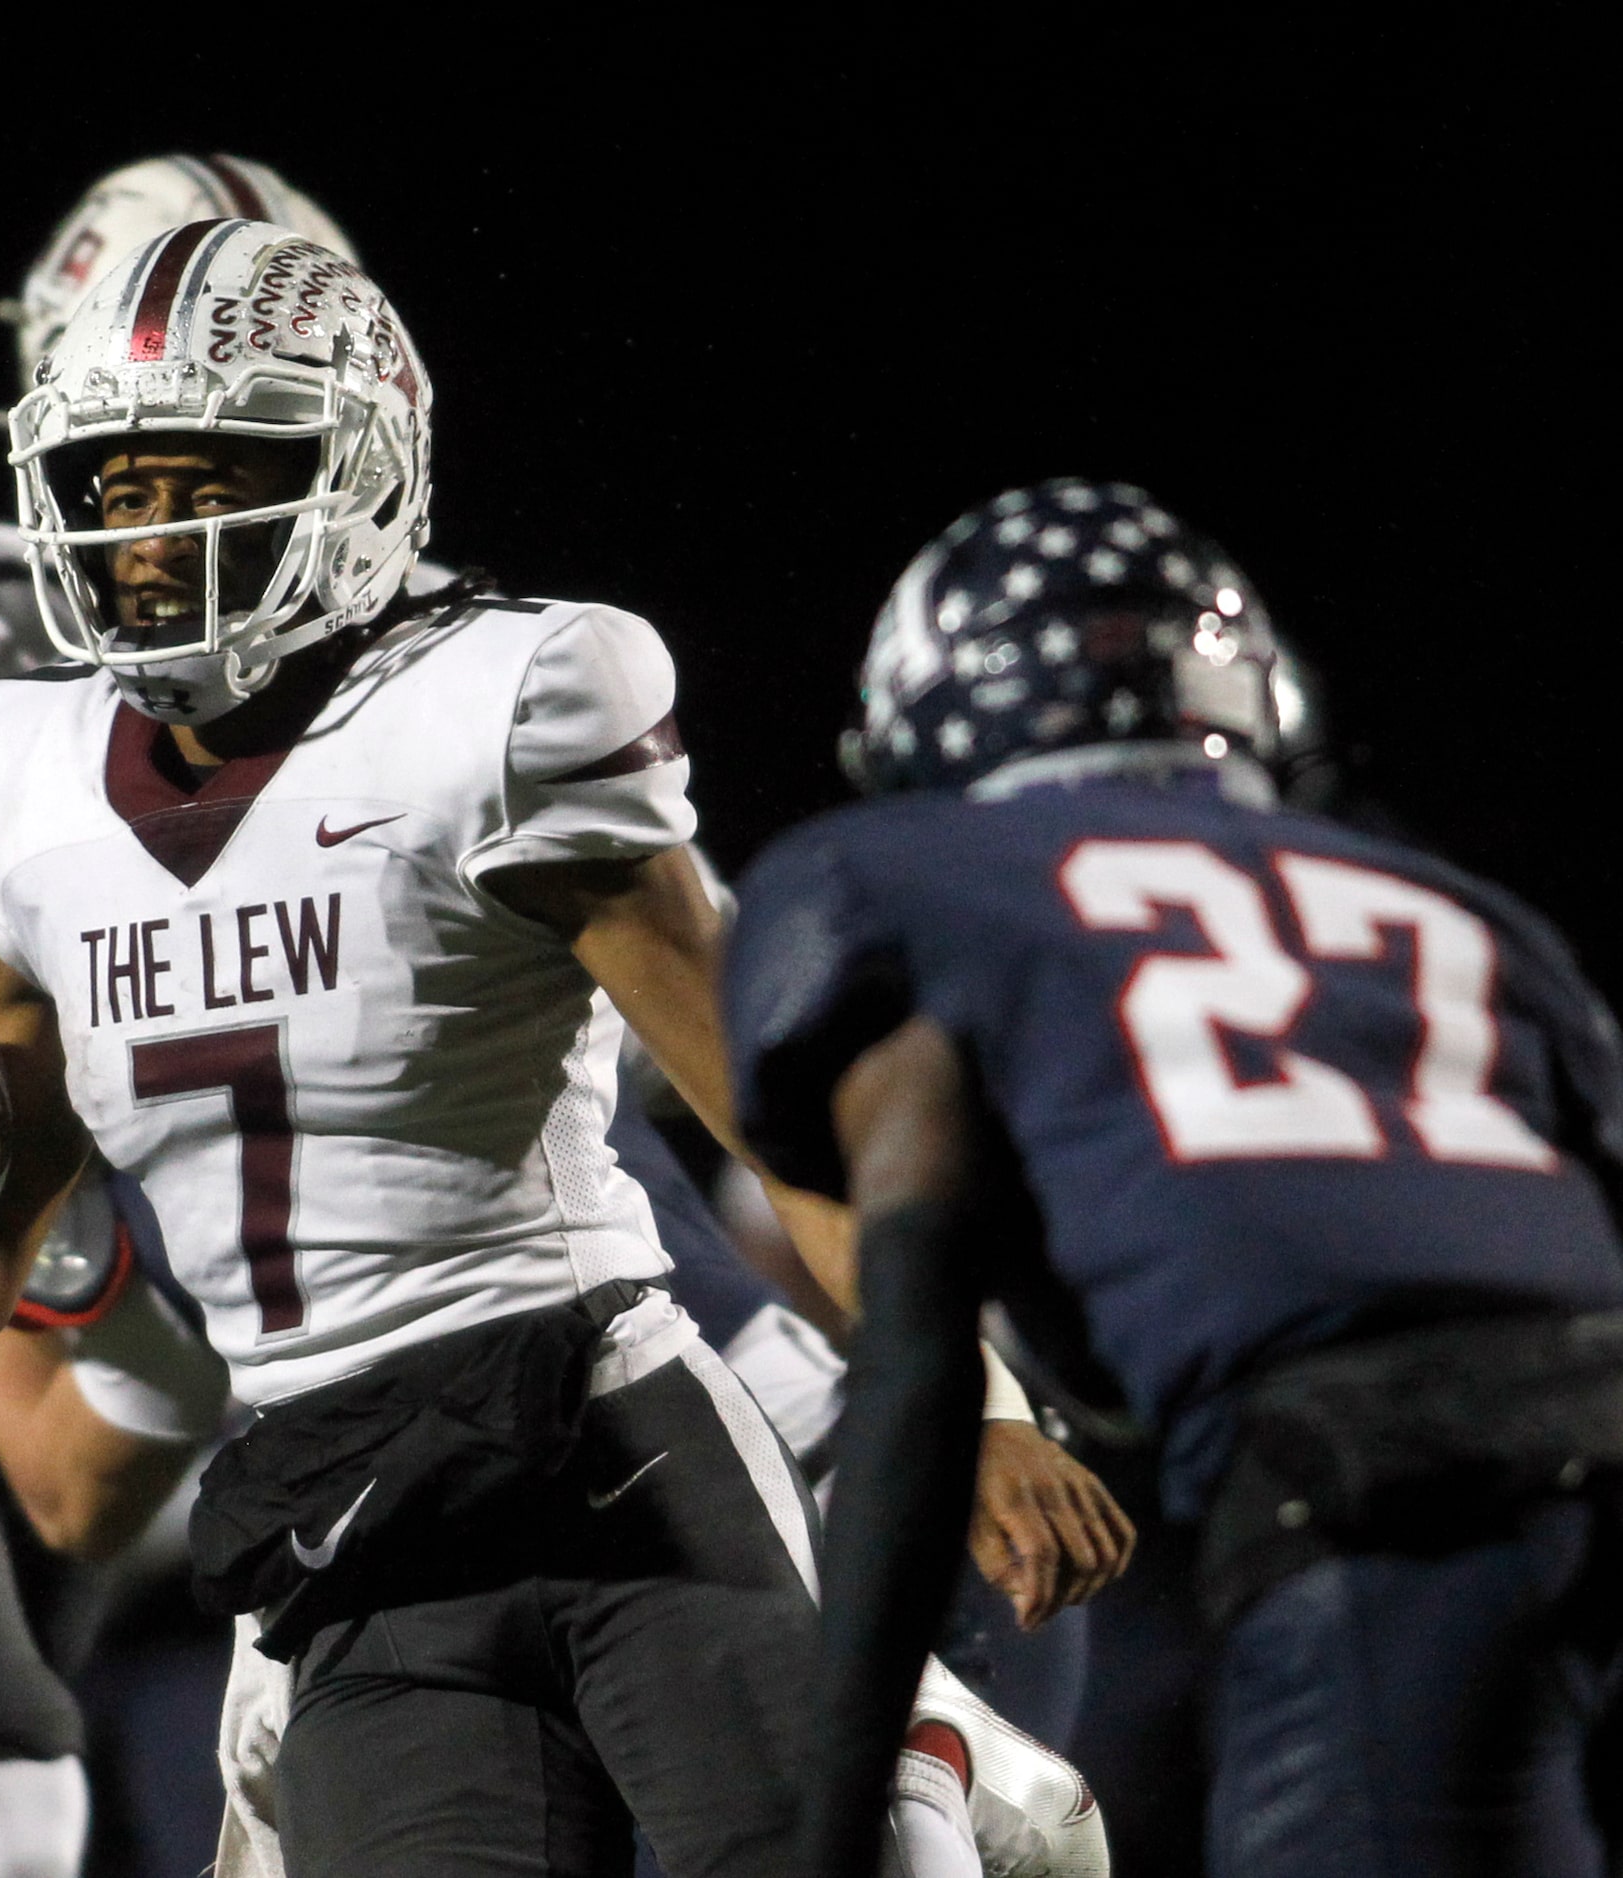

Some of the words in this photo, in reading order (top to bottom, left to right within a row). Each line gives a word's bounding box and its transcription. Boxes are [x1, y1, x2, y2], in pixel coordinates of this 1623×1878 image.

[81, 918, 175, 1028] THE
[199, 892, 341, 1010] LEW
[1058, 838, 1561, 1173] 27
[126, 1015, 311, 1345] 7
